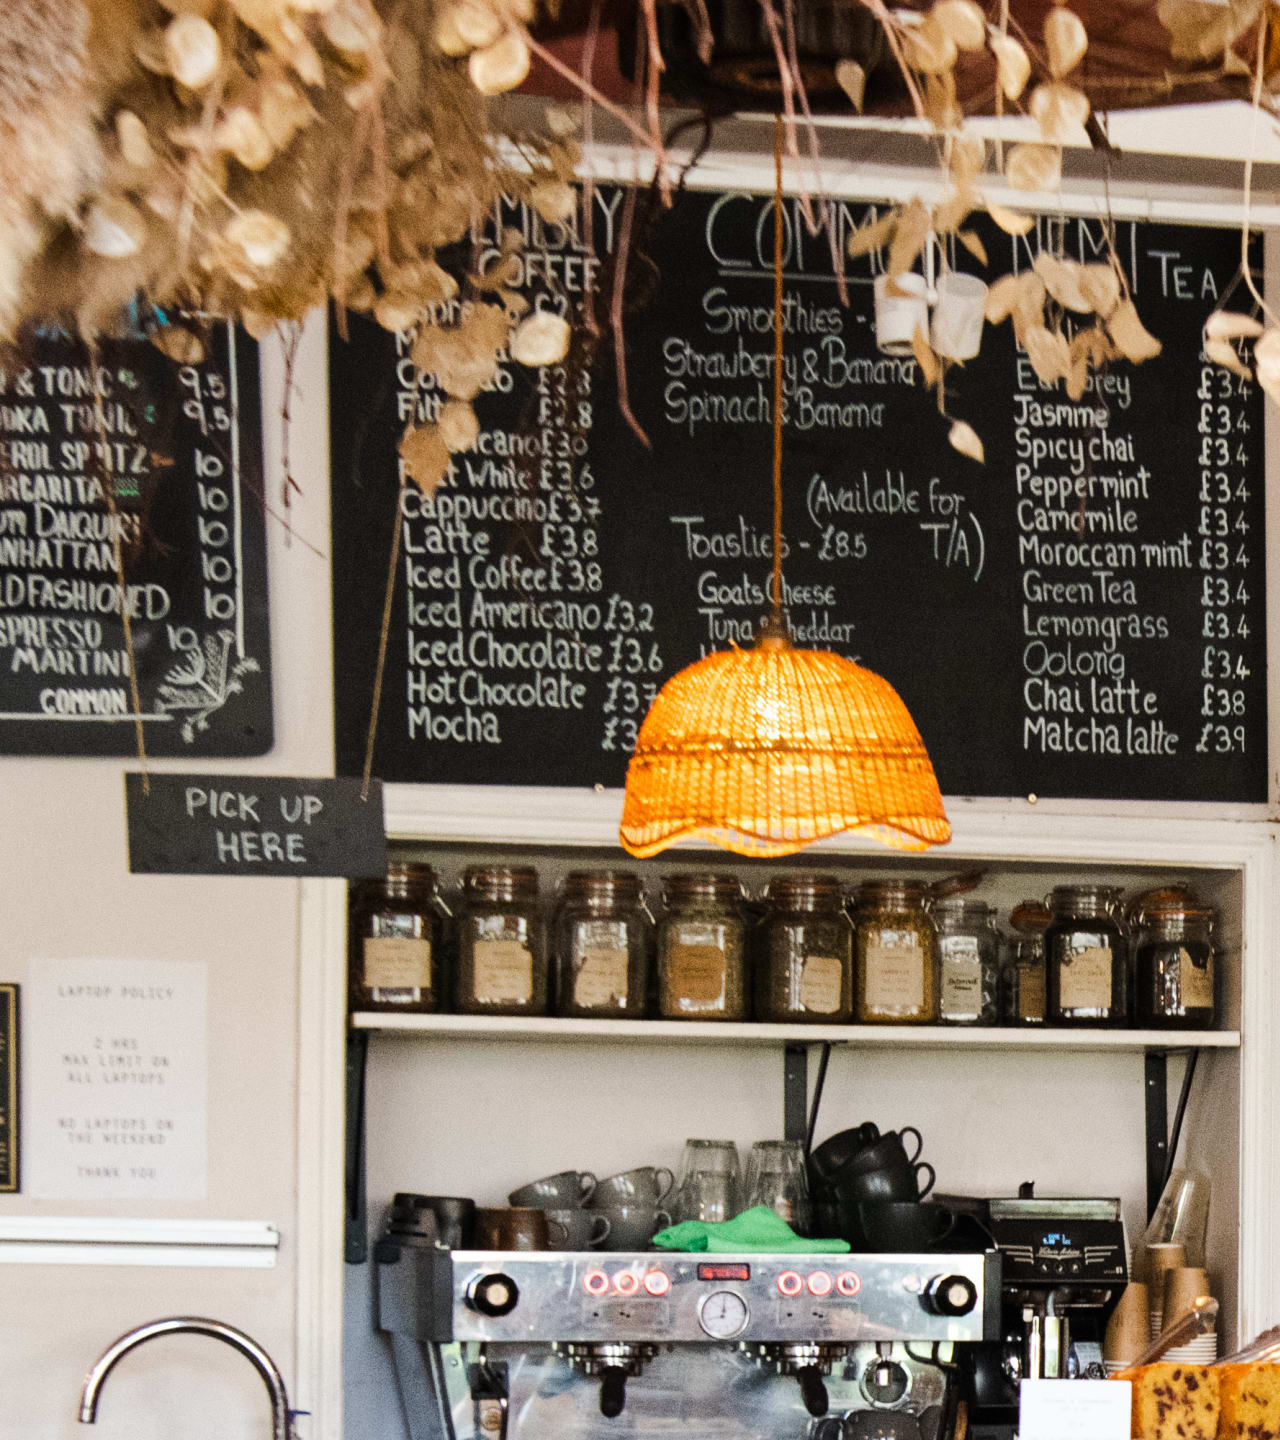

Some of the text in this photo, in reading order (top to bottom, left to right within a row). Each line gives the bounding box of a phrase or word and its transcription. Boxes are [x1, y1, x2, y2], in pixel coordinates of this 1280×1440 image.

[1147, 250, 1219, 300] TEA
[803, 347, 818, 383] &
[820, 336, 917, 389] Banana
[179, 367, 226, 399] 9.5
[182, 399, 230, 436] 9.5
[796, 386, 885, 431] Banana
[1014, 395, 1250, 435] Jasmine £3.4
[195, 449, 223, 478] 10
[1015, 427, 1248, 475] Spicy chai £3.4
[465, 459, 530, 489] White
[1016, 463, 1250, 508] Peppermint £3.4
[198, 482, 228, 512] 10
[930, 477, 965, 515] for
[198, 516, 229, 547] 10
[1017, 499, 1249, 536] Camomile £3.4
[403, 520, 598, 557] Latte £3.8
[670, 514, 868, 561] Toasties £8.5
[1019, 532, 1249, 569] Moroccan mint £3.4
[202, 552, 232, 583] 10
[406, 555, 602, 592] Iced Coffee £3.8
[204, 587, 235, 619] 10
[697, 570, 766, 605] Goats
[1023, 569, 1250, 607] Green Tea £3.4
[408, 590, 654, 632] Iced Americano £3.2
[698, 607, 754, 641] Tuna
[1023, 604, 1250, 652] Lemongrass £3.4
[166, 624, 198, 650] 10
[408, 630, 468, 668] Iced
[468, 631, 603, 672] Chocolate
[607, 633, 663, 674] £3.6
[11, 648, 130, 677] MARTINI
[1023, 640, 1250, 680] Oolong £3.4
[407, 669, 456, 705] Hot
[458, 669, 587, 710] Chocolate
[1024, 677, 1084, 713] Chai
[1091, 676, 1158, 714] latte
[407, 705, 502, 743] Mocha
[1024, 716, 1245, 754] Matcha latte £3.9
[185, 786, 324, 825] PICK UP
[215, 830, 307, 863] HERE
